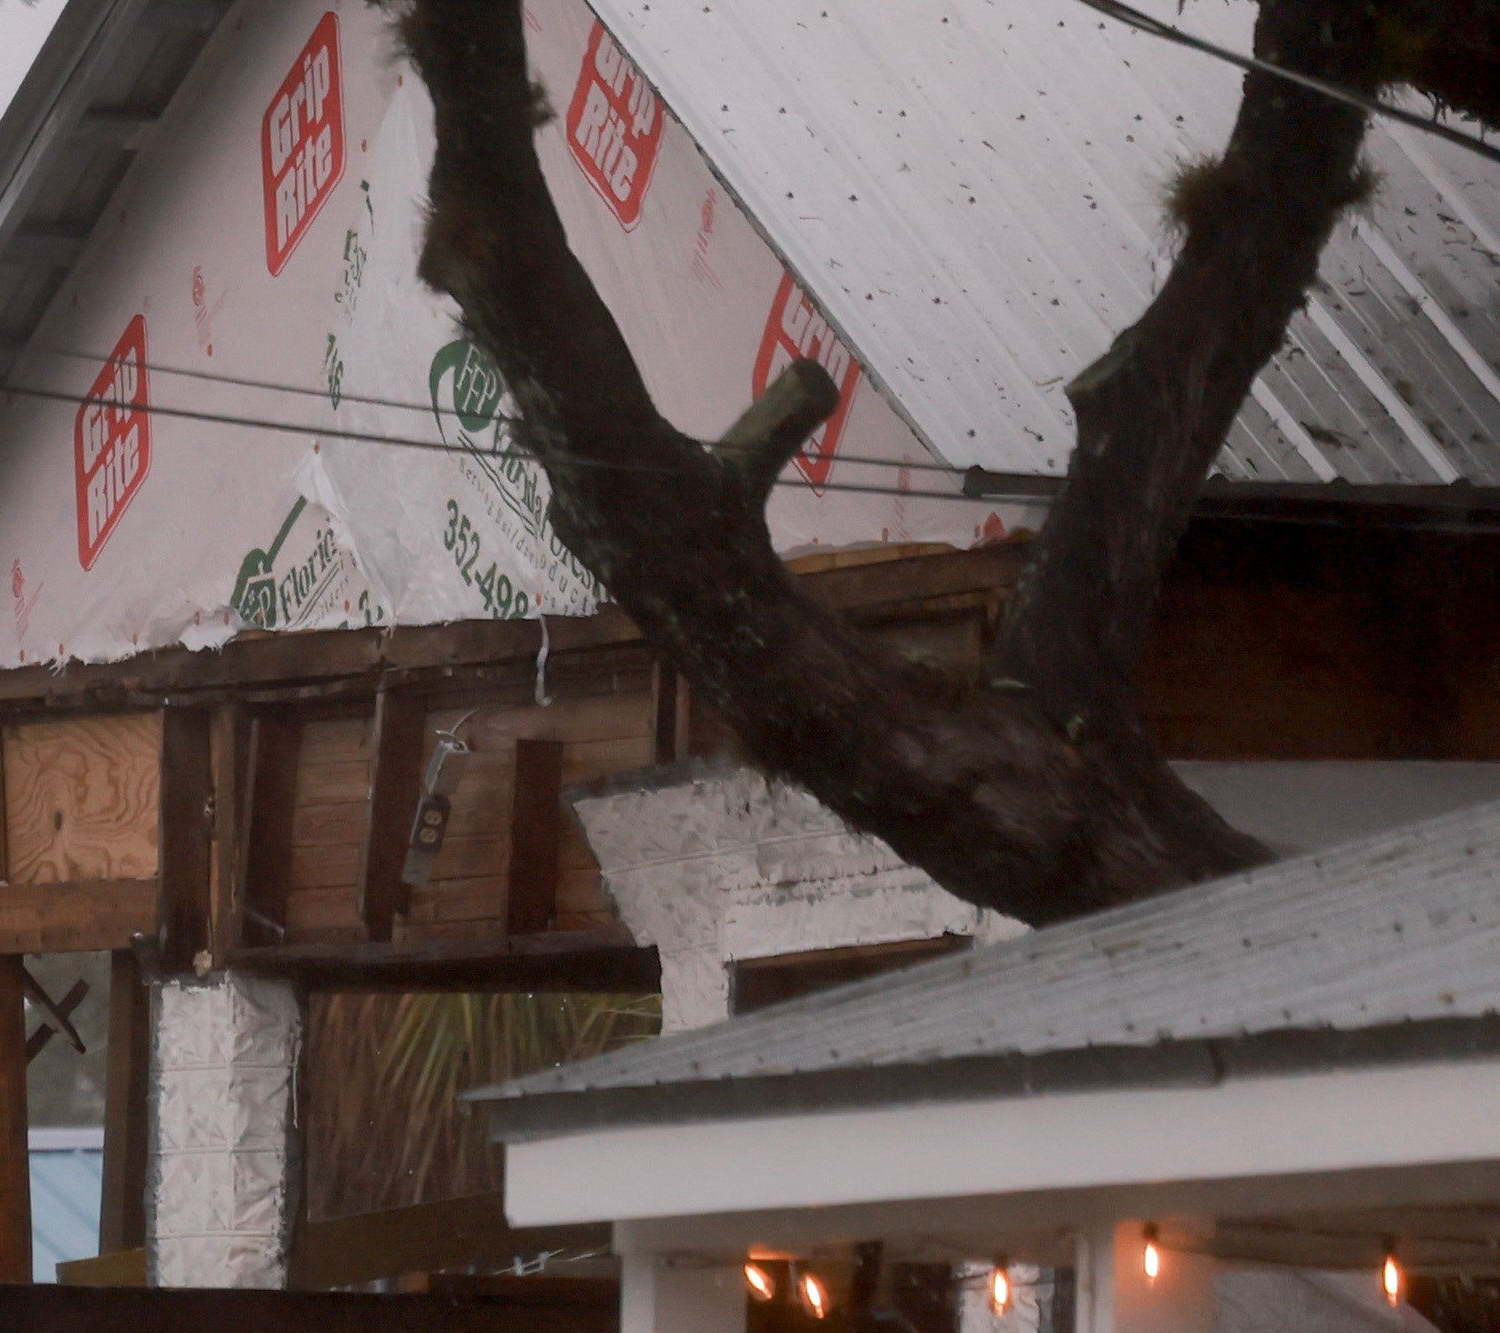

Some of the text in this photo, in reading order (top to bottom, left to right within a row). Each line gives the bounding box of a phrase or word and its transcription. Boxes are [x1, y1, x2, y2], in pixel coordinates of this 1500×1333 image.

[270, 45, 330, 178] Grip
[575, 80, 638, 202] Rite
[276, 123, 332, 253] Rite
[82, 346, 137, 475] Grip
[87, 423, 139, 549] Rite
